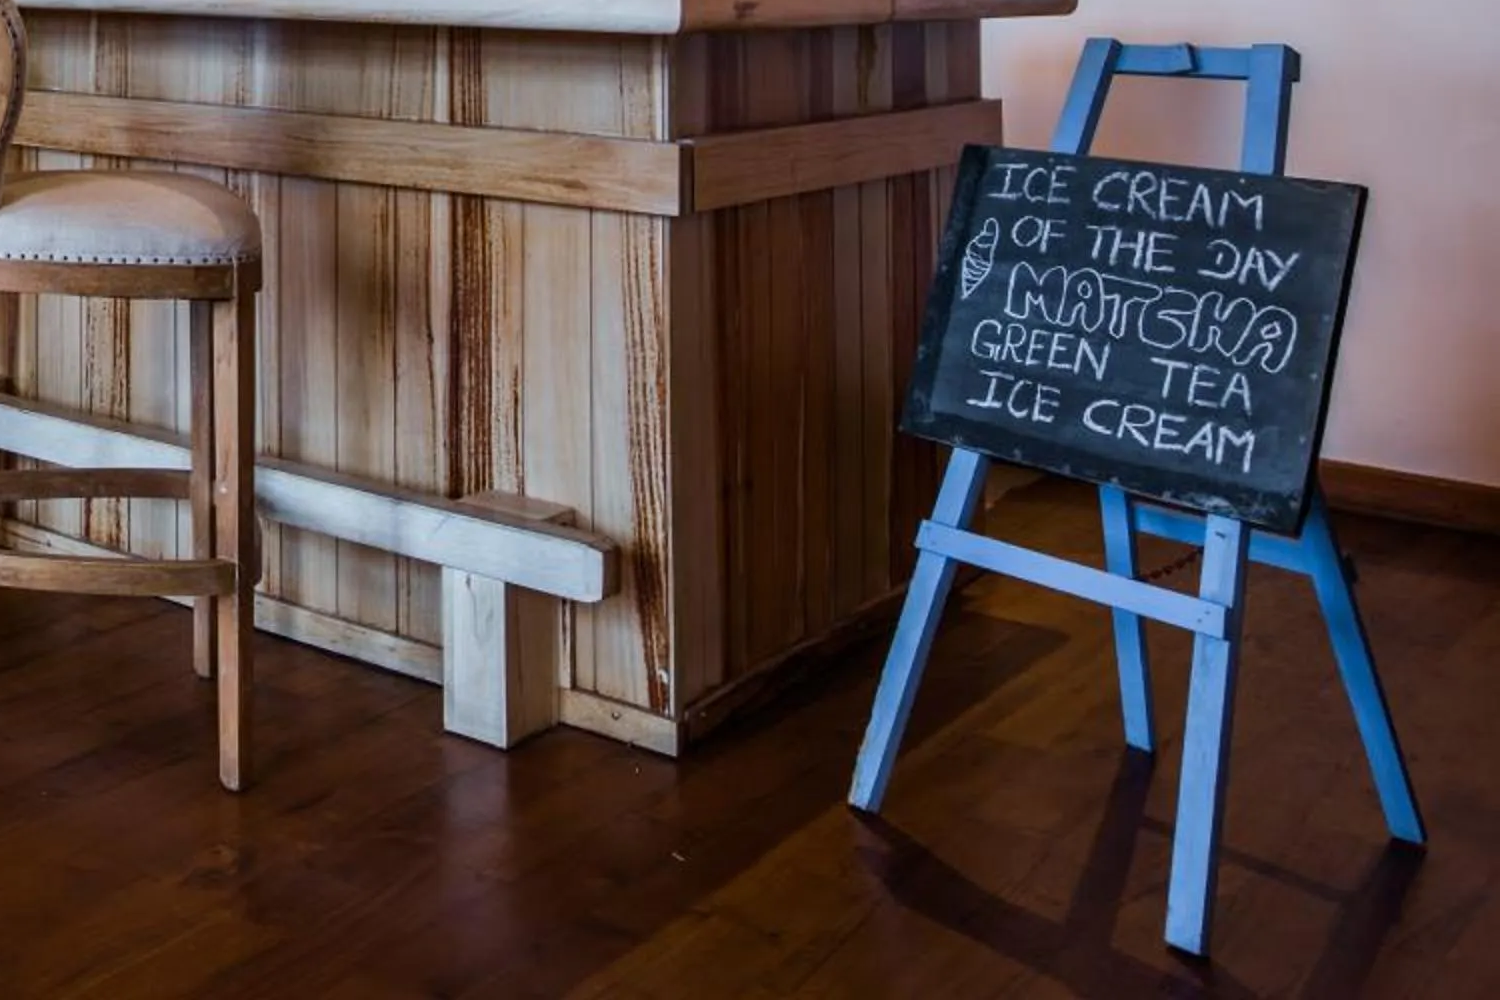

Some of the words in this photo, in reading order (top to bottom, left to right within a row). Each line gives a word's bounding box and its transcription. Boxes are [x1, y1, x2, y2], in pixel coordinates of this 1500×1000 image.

[987, 162, 1077, 204] ICE
[1092, 171, 1264, 231] CREAM
[1011, 216, 1067, 253] OF
[1086, 225, 1179, 273] THE
[1197, 238, 1300, 291] DAY
[1004, 261, 1297, 374] MATCHA
[971, 319, 1111, 381] GREEN
[1150, 357, 1253, 415] TEA
[966, 369, 1060, 423] ICE
[1083, 400, 1256, 473] CREAM
